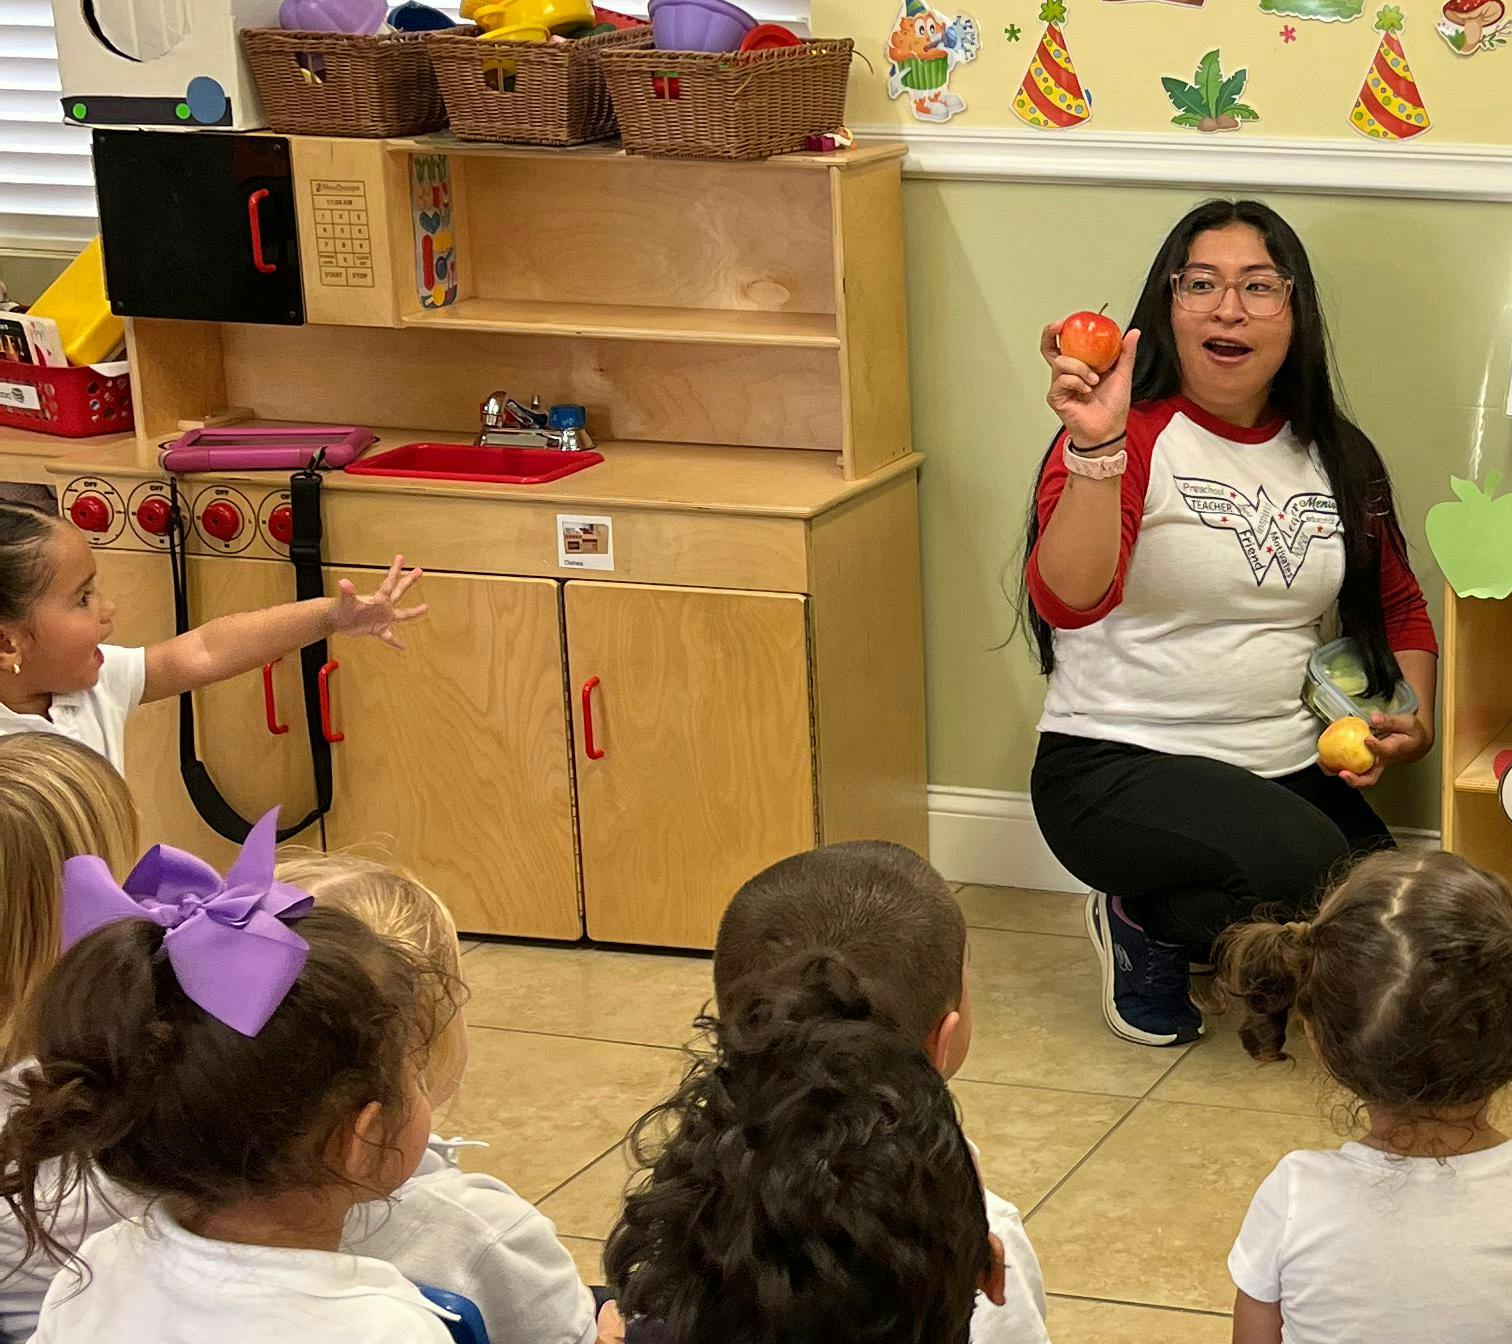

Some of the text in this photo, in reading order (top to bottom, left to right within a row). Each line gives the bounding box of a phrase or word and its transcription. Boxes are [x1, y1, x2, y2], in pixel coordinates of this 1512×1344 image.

[1183, 482, 1225, 496] Preschool
[1191, 499, 1233, 513] TEACHER
[1238, 529, 1267, 572] Friend
